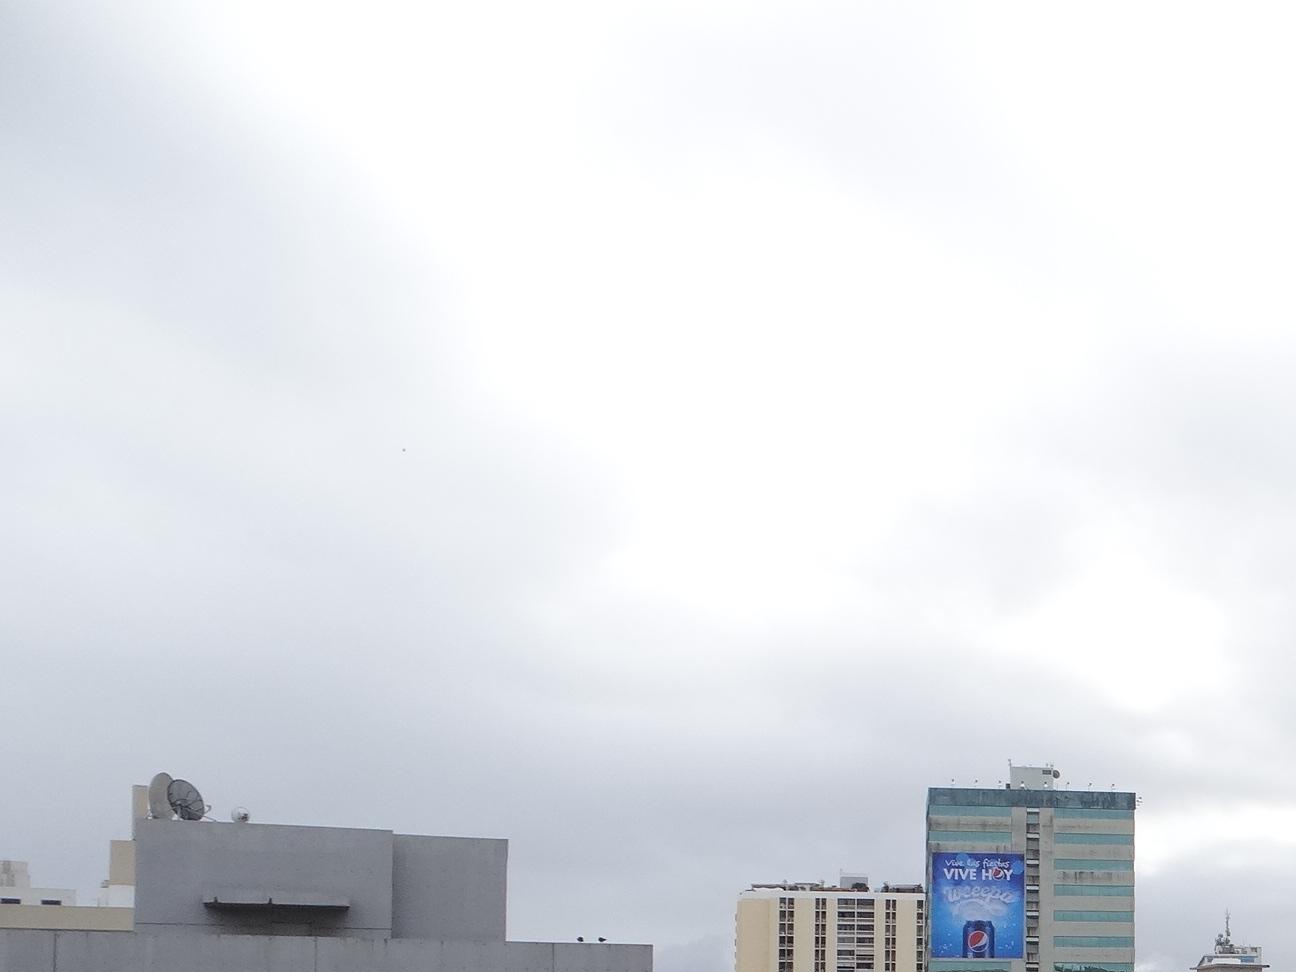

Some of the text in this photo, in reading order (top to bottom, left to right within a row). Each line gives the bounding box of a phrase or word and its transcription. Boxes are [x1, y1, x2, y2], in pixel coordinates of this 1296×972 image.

[983, 858, 1010, 869] fiestas
[943, 867, 1013, 881] VIVE HOY
